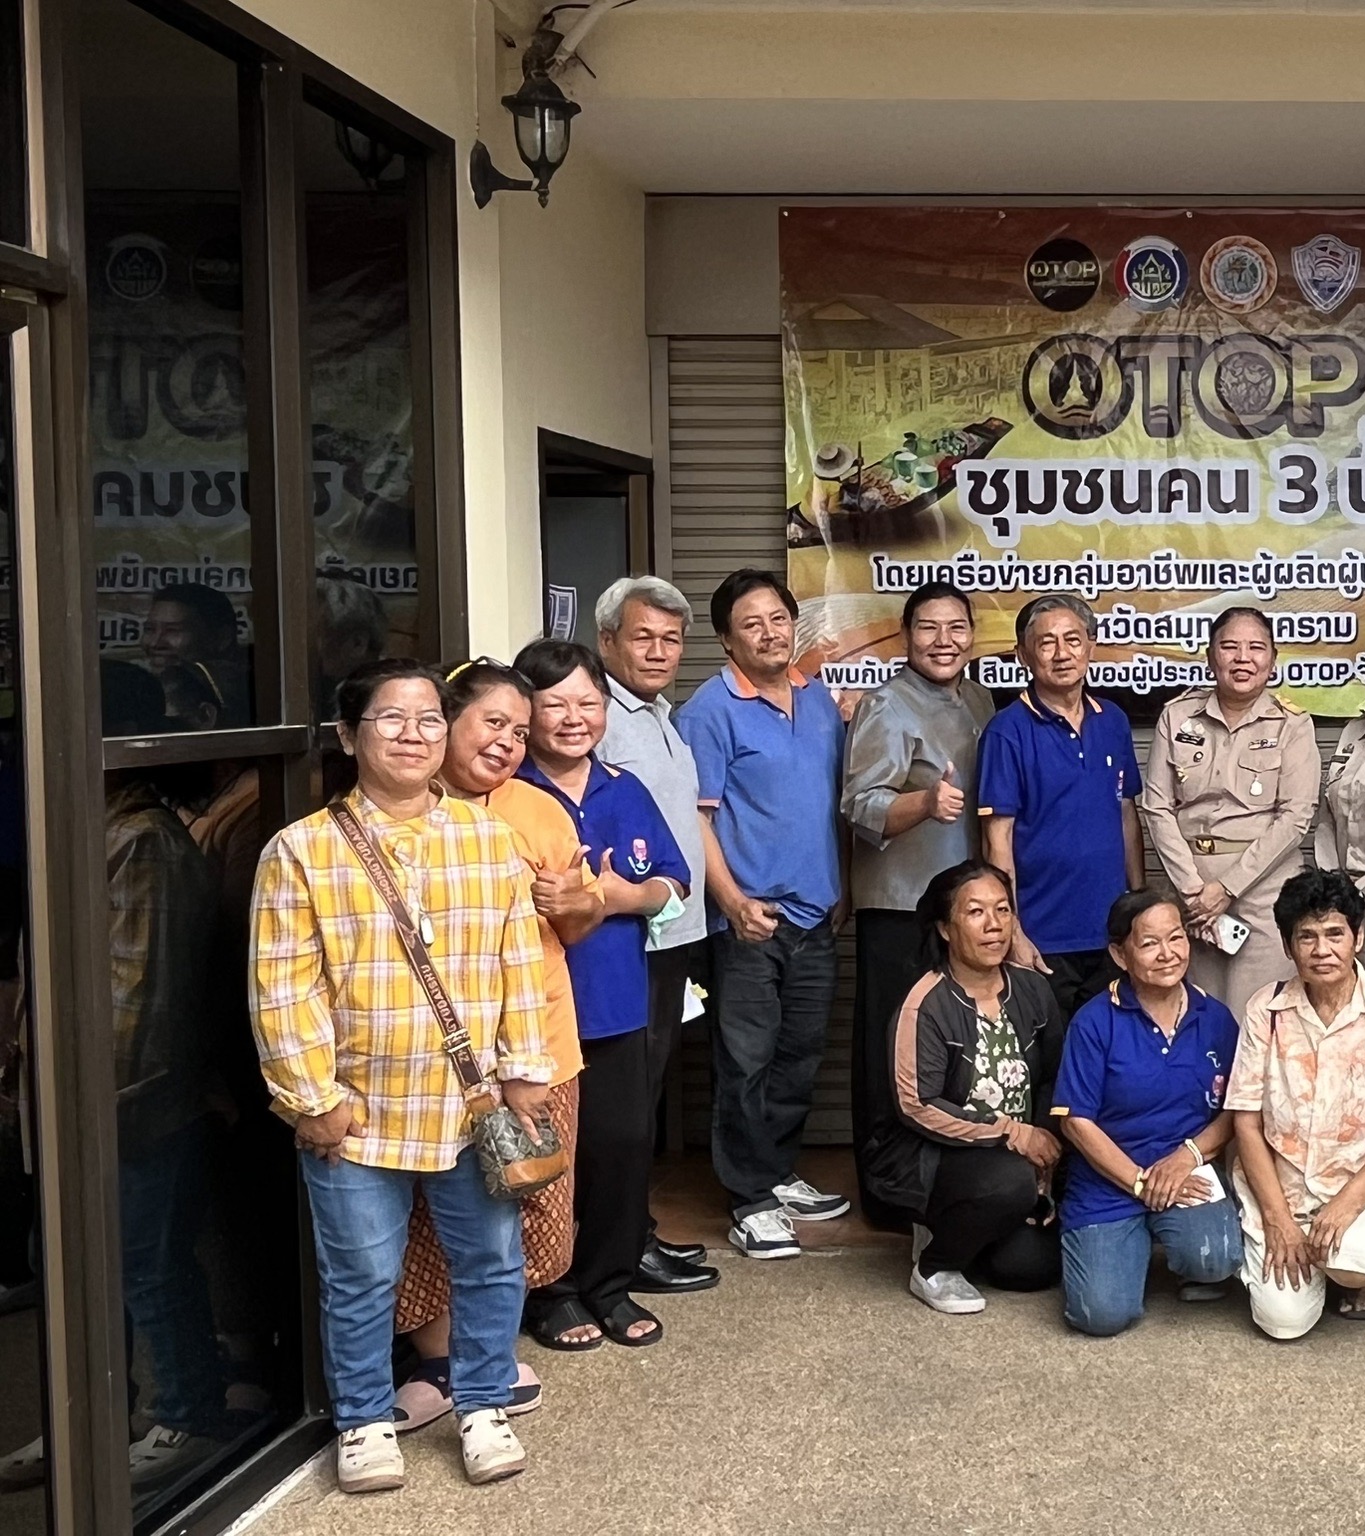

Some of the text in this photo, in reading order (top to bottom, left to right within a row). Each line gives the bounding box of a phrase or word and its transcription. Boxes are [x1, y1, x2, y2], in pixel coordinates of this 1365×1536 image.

[1029, 260, 1097, 279] OTOP
[966, 468, 1250, 537] ชุมชนคน
[1277, 454, 1320, 514] 3
[1287, 662, 1349, 682] OTOP
